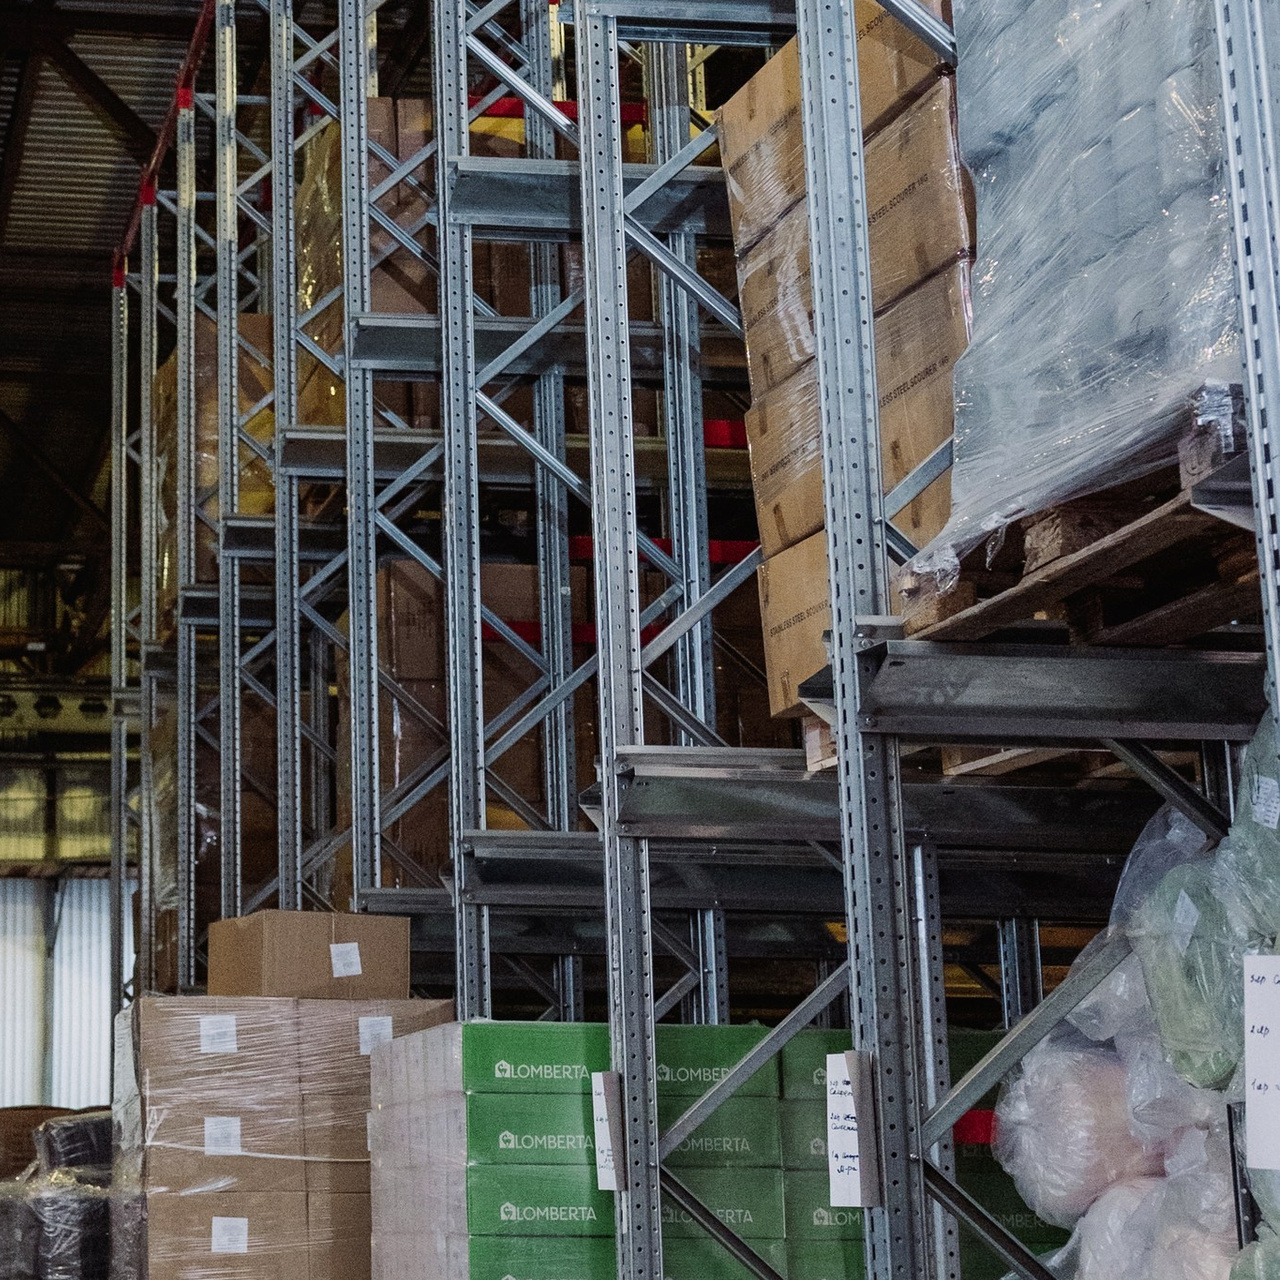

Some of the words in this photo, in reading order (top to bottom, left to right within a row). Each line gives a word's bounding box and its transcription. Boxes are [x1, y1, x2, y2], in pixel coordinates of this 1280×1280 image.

[872, 205, 889, 223] STEEL
[890, 182, 916, 209] SCOURER
[893, 382, 910, 398] STEEL
[910, 362, 937, 387] SCOURER
[510, 1064, 591, 1079] LOMBERTA
[515, 1134, 594, 1149] LOMBERTA
[678, 1137, 751, 1152] OMBERTA
[516, 1206, 597, 1221] LOMBERTA
